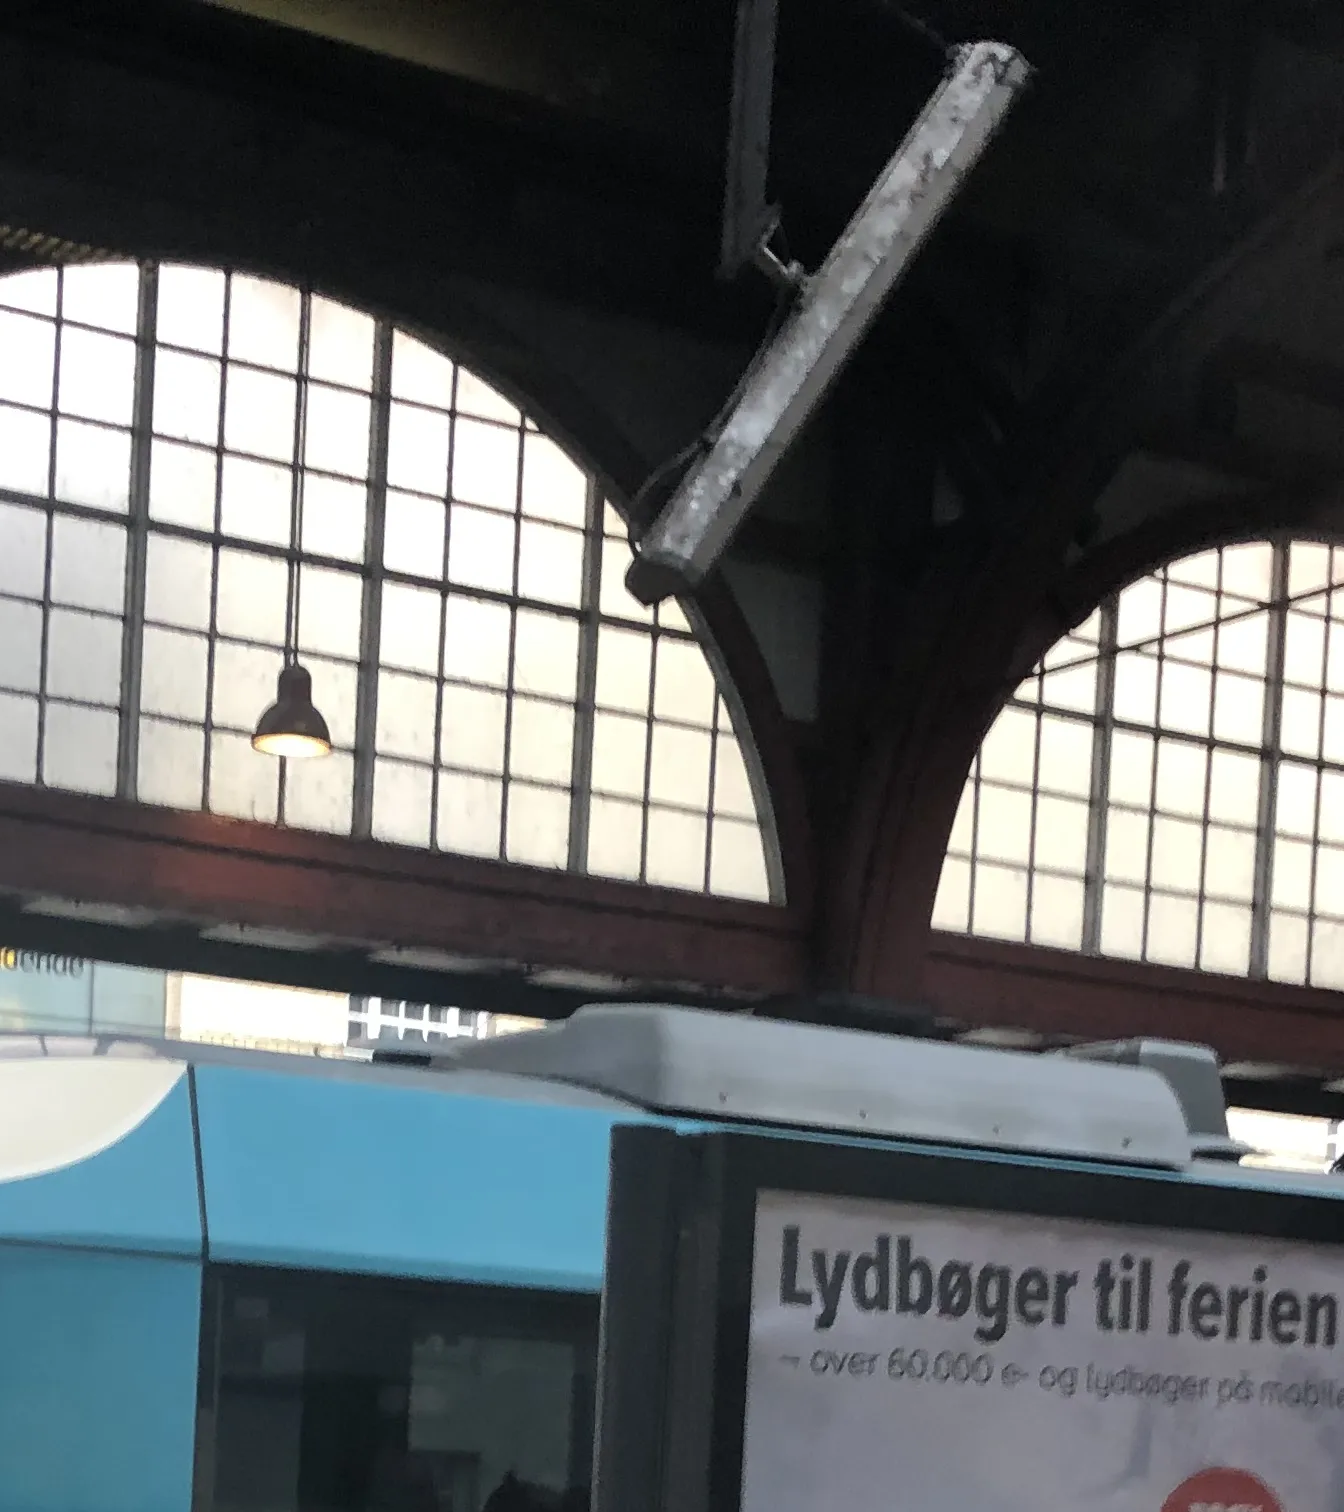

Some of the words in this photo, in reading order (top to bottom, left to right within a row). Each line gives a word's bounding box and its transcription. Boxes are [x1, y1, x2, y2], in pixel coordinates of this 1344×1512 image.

[780, 1225, 1080, 1342] Lydbøger
[1093, 1254, 1153, 1335] til
[1167, 1258, 1340, 1348] ferien
[809, 1349, 881, 1377] over
[887, 1347, 995, 1385] 60.000
[1039, 1364, 1080, 1399] og
